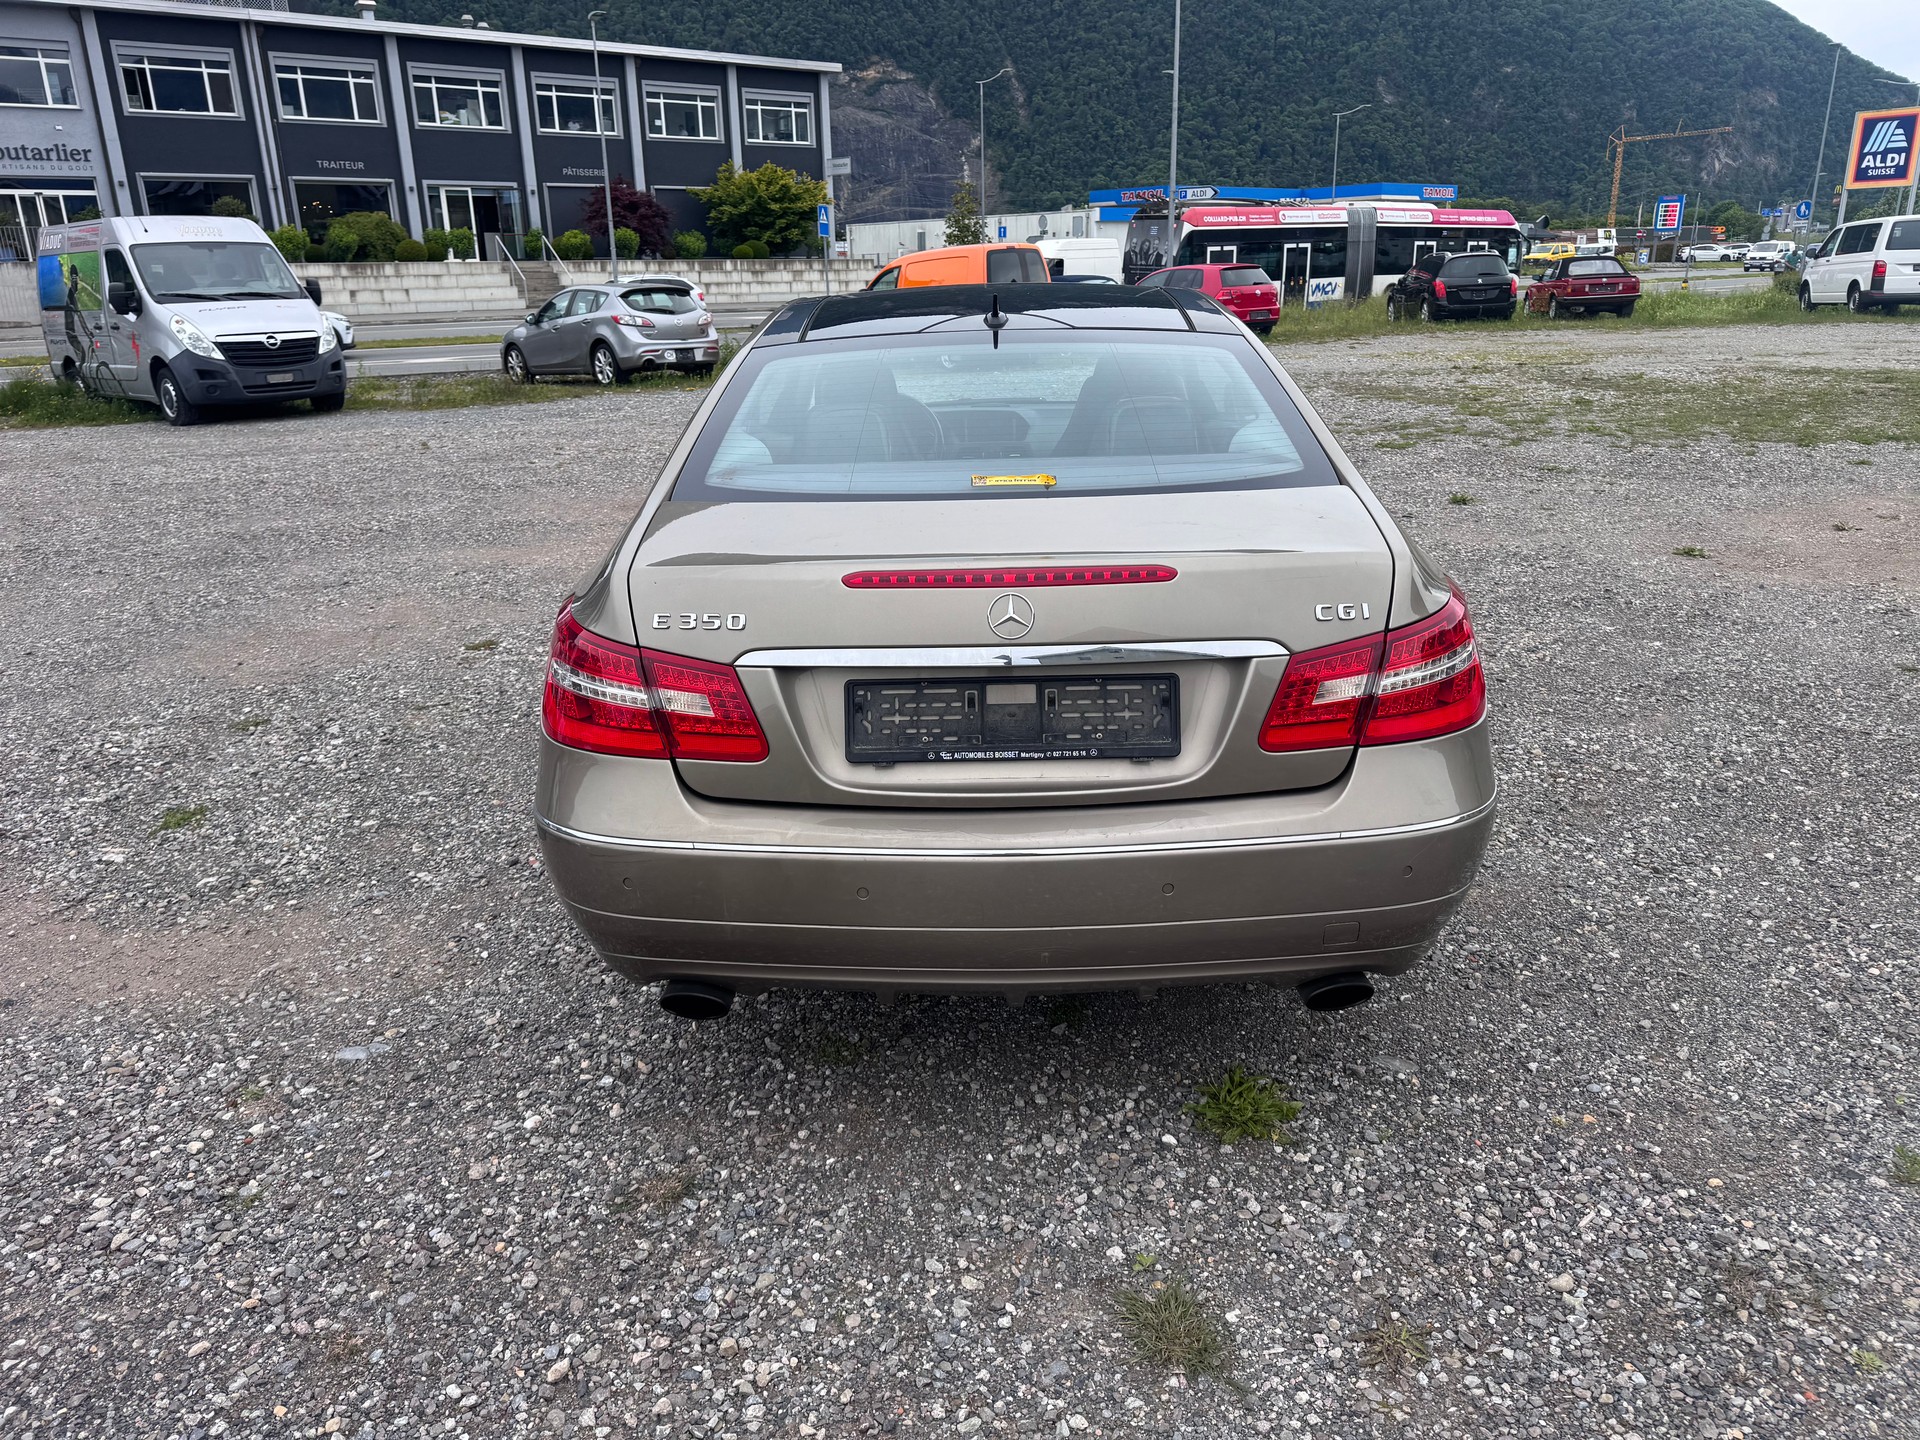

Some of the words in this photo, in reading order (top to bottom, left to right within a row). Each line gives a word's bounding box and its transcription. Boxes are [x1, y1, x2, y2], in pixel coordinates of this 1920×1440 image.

[316, 160, 365, 170] TRAITEUR
[1861, 152, 1906, 168] ALDI
[562, 166, 606, 177] PÂTISSERIE
[1867, 167, 1896, 176] SUISSE
[1121, 189, 1166, 202] TAMOIL
[1191, 190, 1207, 198] ALDI
[1423, 187, 1455, 198] TAMOIL
[1314, 602, 1371, 622] CGI
[652, 612, 672, 630] E
[678, 612, 747, 631] 350
[953, 751, 994, 759] AUTOMOBILES
